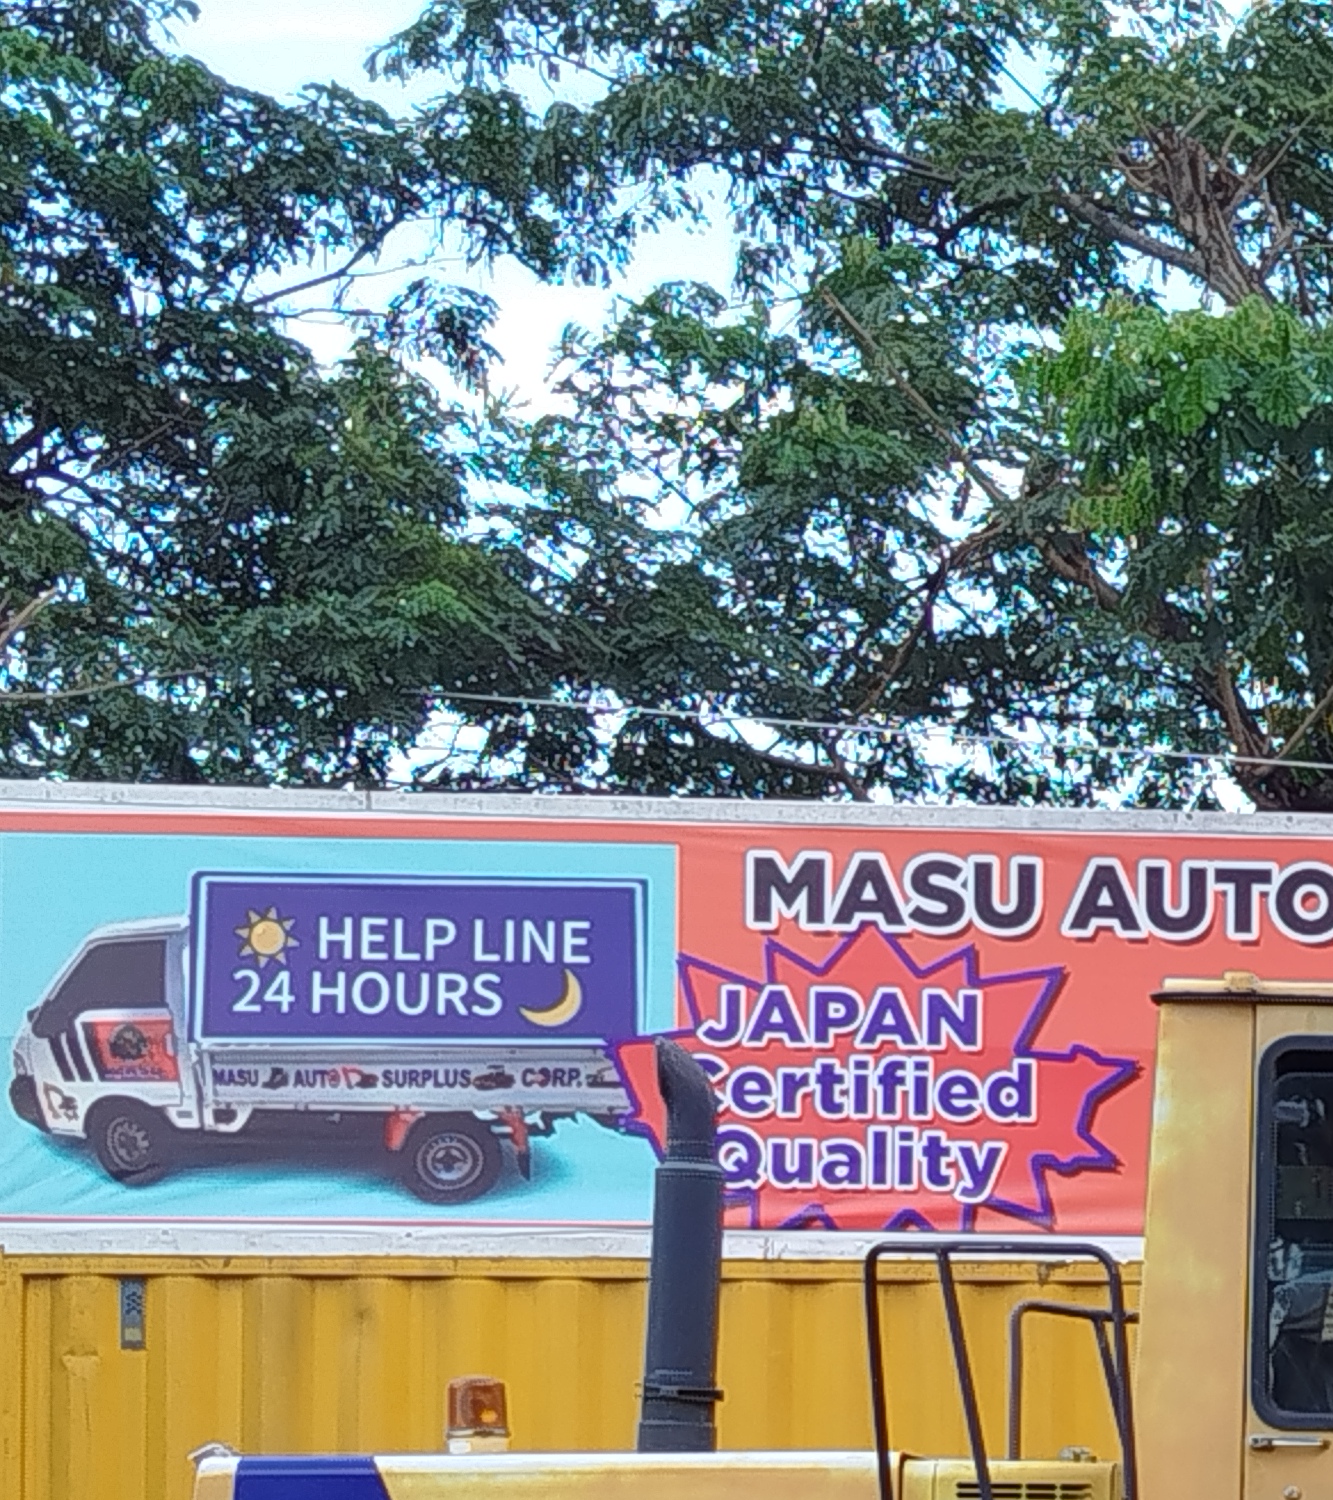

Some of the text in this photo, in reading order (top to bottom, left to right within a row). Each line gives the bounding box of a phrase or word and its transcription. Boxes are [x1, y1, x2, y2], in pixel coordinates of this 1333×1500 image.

[747, 850, 1041, 930] MASU
[317, 915, 592, 964] HELP LINE
[232, 968, 503, 1016] 24 HOURS
[698, 985, 983, 1050] JAPAN
[212, 1066, 583, 1089] MASU AUTO SURPLUS CORP.
[717, 1126, 1007, 1201] Quality
